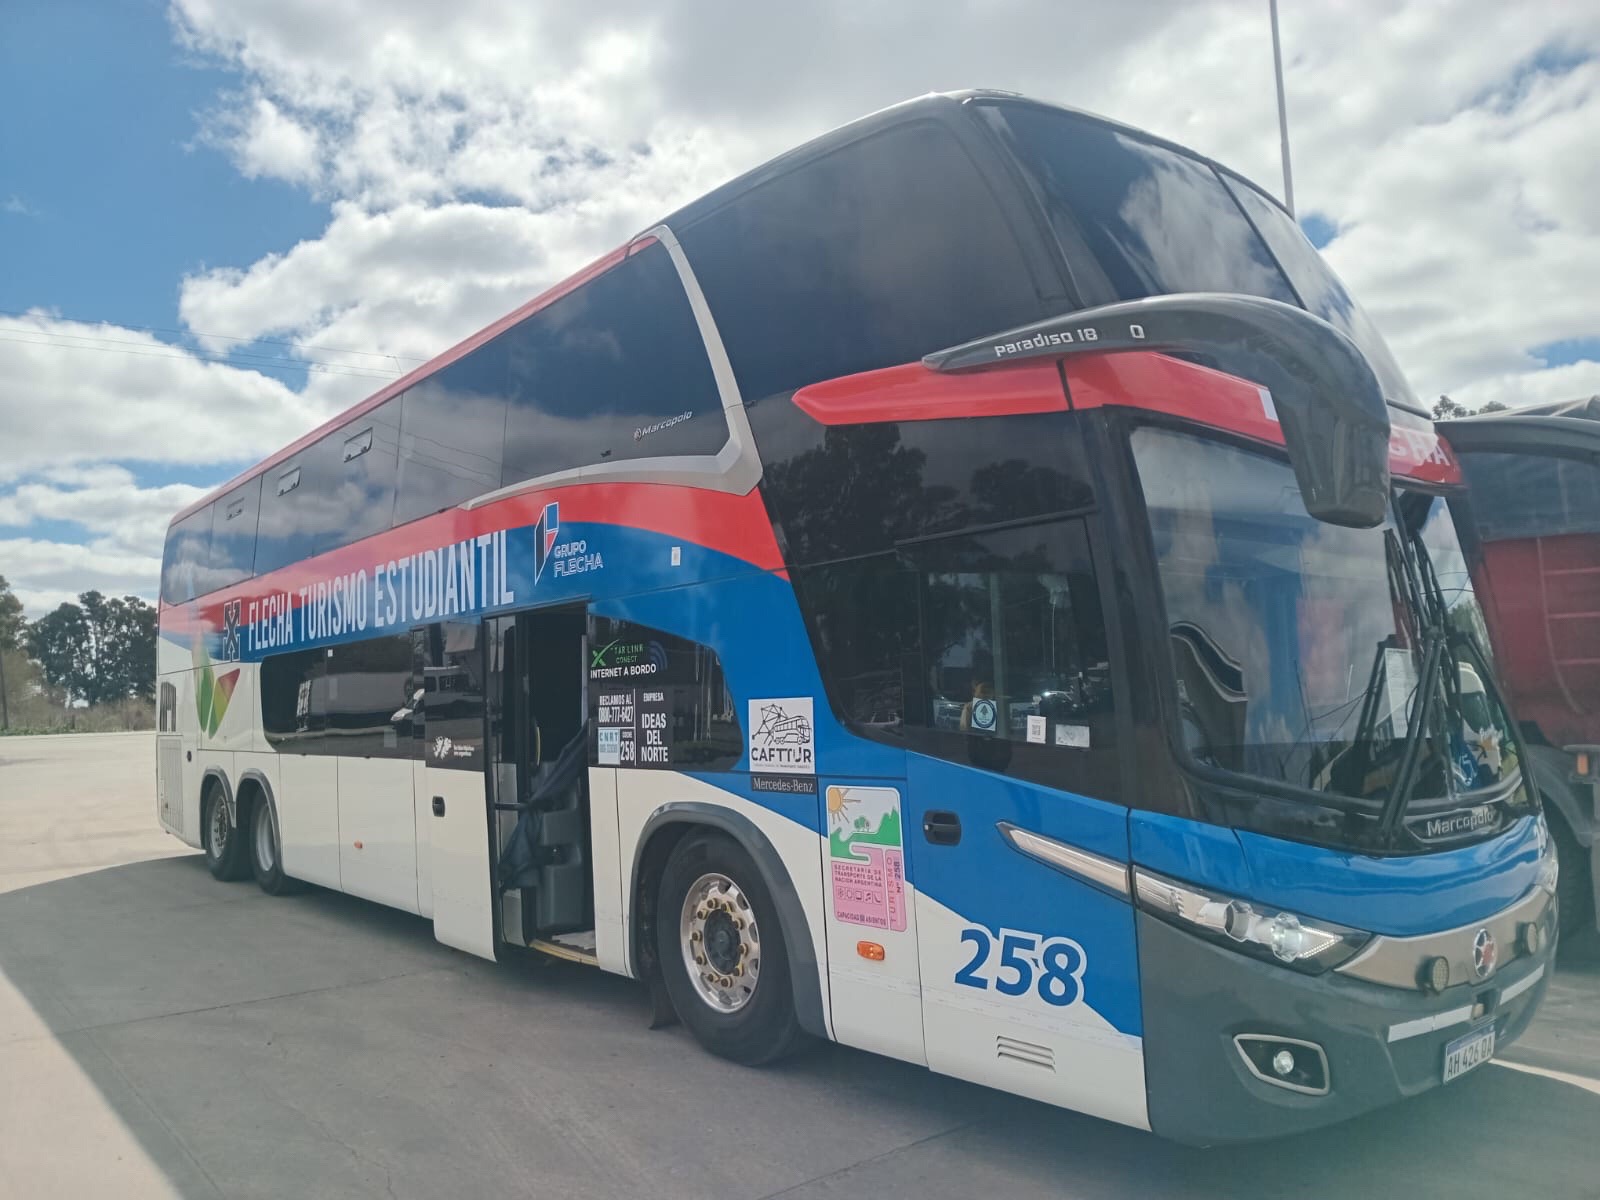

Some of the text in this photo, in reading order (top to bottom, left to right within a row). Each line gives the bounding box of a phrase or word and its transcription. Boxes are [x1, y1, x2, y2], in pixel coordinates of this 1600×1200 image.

[642, 410, 693, 436] Marcopolo
[554, 540, 587, 559] GRUPO
[554, 552, 604, 578] FLECHA
[248, 529, 514, 650] FLECHA TURISMO ESTUDIANTIL
[590, 663, 657, 679] INTERNET A BORDO
[599, 693, 633, 706] RECLAMOS AL
[643, 692, 664, 702] EMPRESA
[641, 713, 667, 729] IDEAS
[646, 729, 663, 745] DEL
[620, 741, 635, 761] 258
[641, 746, 669, 762] NORTE
[752, 777, 814, 793] Mercedes-Benz
[1426, 808, 1494, 837] Marcopolo
[886, 857, 897, 922] TURISMO
[954, 926, 1085, 1007] 258
[1447, 1052, 1460, 1078] AH
